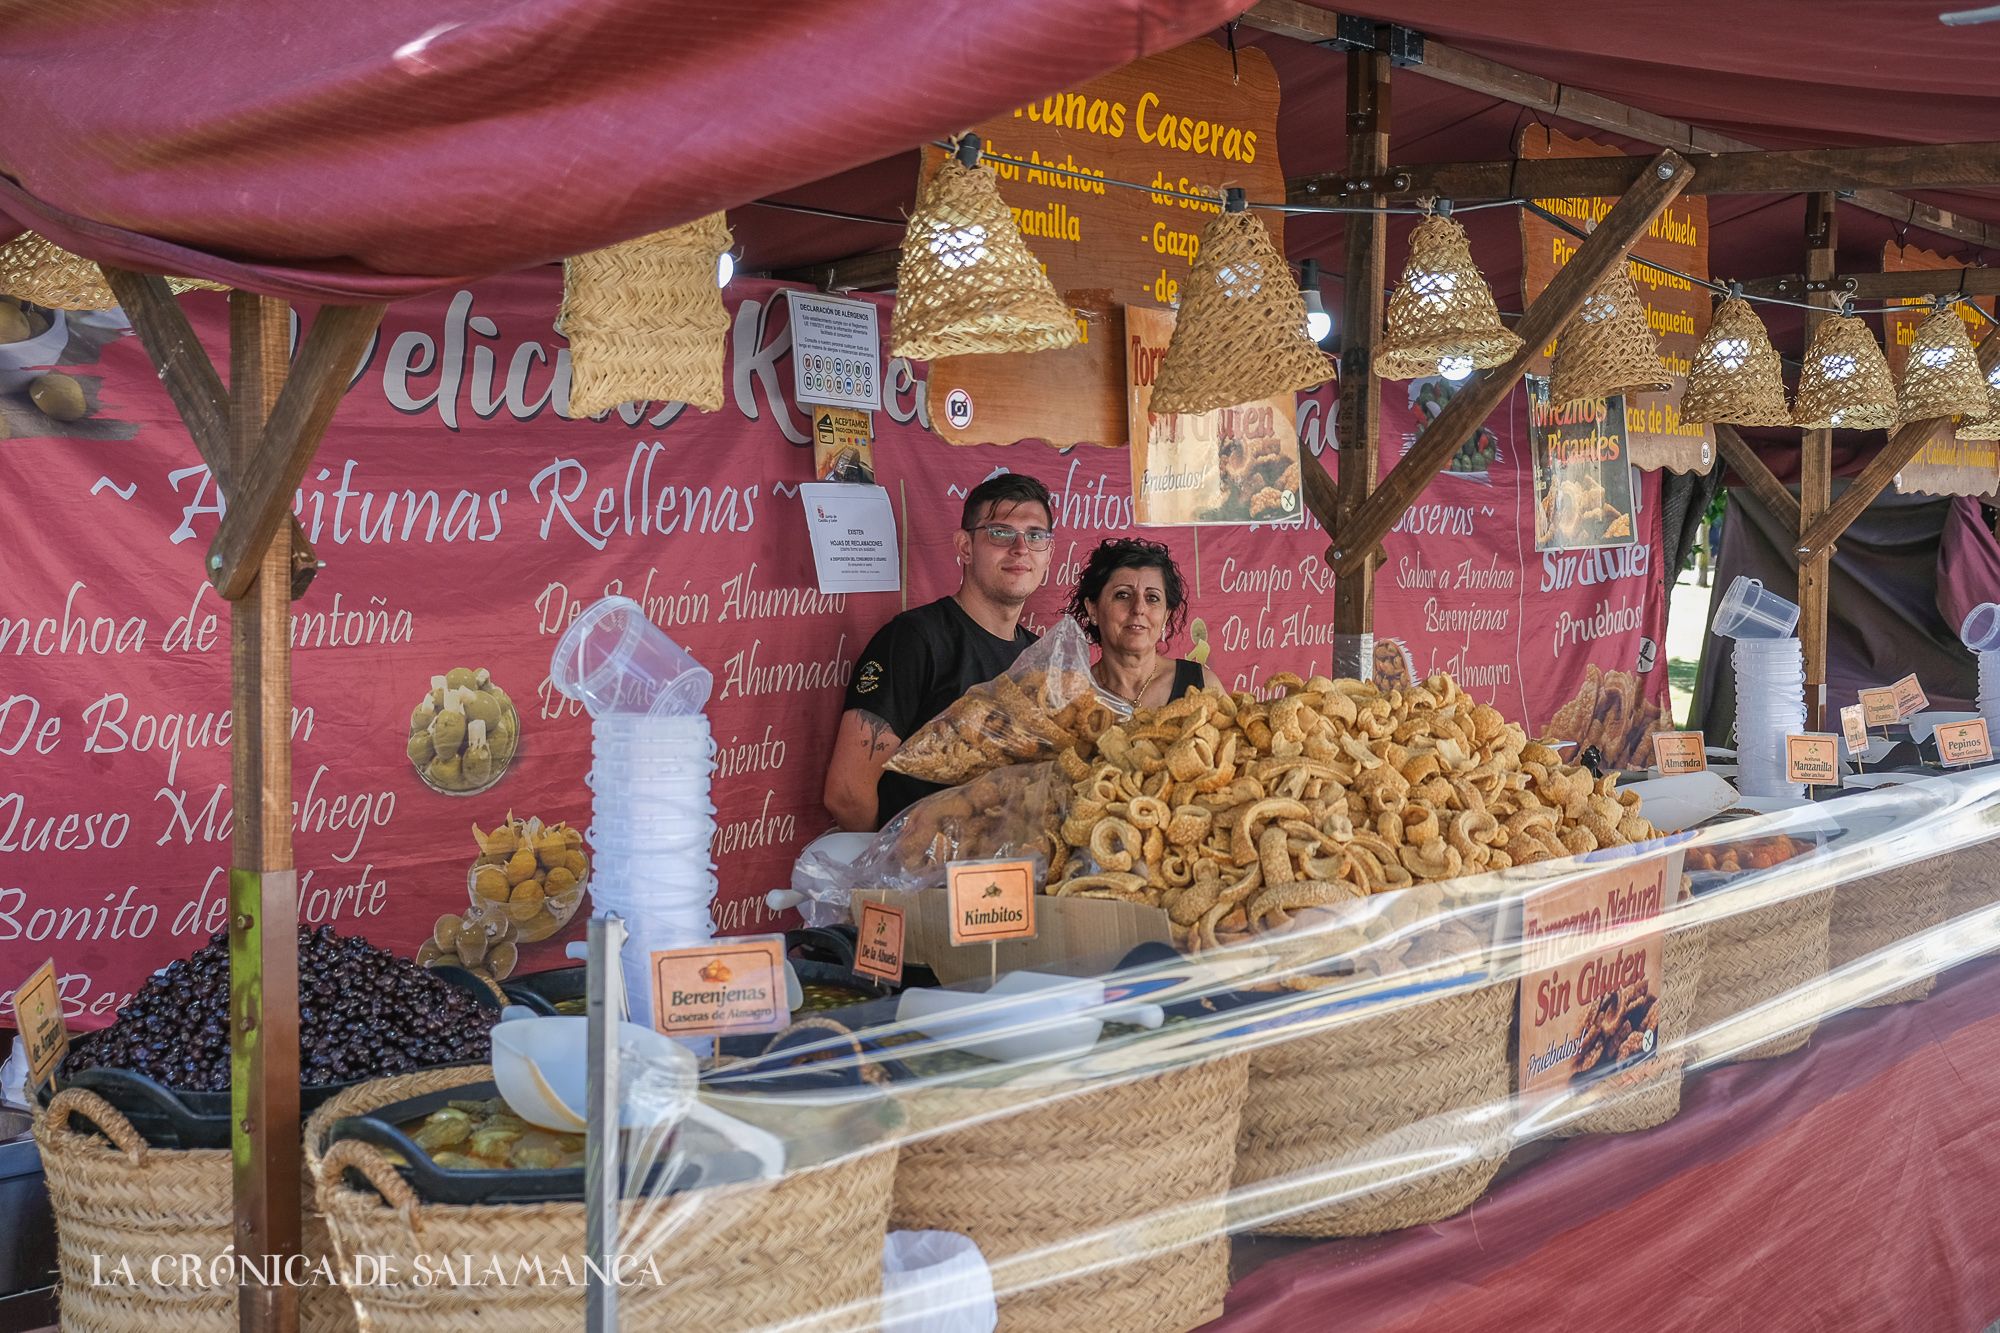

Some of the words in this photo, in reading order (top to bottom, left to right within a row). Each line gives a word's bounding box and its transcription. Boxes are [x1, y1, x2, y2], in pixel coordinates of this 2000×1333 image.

[1136, 92, 1257, 164] Caseras
[980, 139, 1024, 181] bor
[1027, 150, 1105, 195] Anchoa
[1151, 171, 1174, 206] de
[1661, 208, 1697, 247] Abuela
[1155, 269, 1178, 303] de
[800, 303, 834, 314] DECLARACIÓN
[842, 310, 869, 321] ALÉRGENOS
[834, 417, 868, 429] ACEPTAMOS
[1648, 401, 1661, 433] de
[1547, 428, 1620, 466] Picantes
[529, 441, 758, 550] Rellenas
[1220, 557, 1292, 612] Campo
[1396, 551, 1436, 589] Sabor
[1439, 569, 1449, 589] a
[1453, 552, 1514, 590] Anchoa
[1540, 549, 1577, 593] Sin
[0, 581, 146, 656] nchoa
[162, 581, 218, 653] de
[534, 581, 581, 635] De
[1221, 615, 1250, 651] De
[1256, 607, 1275, 649] la
[1280, 604, 1334, 648] Abue
[1424, 597, 1509, 652] Berenjenas
[1553, 594, 1645, 658] ¡Pruébalos!
[720, 633, 852, 700] Ahumado
[1447, 646, 1510, 706] Almagro
[0, 694, 61, 756] De
[82, 692, 315, 785] Boquen
[1948, 738, 1981, 751] Pepinos
[1664, 759, 1701, 768] Almendra
[1793, 760, 1832, 771] Manzanilla
[154, 764, 396, 863] Mahego
[965, 906, 1023, 926] Kimbitos
[1605, 870, 1663, 940] Natural
[862, 944, 871, 959] De
[871, 946, 876, 960] la
[878, 948, 897, 966] Abuela
[671, 985, 766, 1007] Berenjenas
[1535, 971, 1571, 1027] Sin
[1576, 949, 1646, 1006] Gluten
[668, 1012, 709, 1023] Caseras
[712, 1010, 725, 1020] de
[727, 1007, 772, 1021] Almagro
[1525, 1028, 1587, 1089] ¡Pruébalos!
